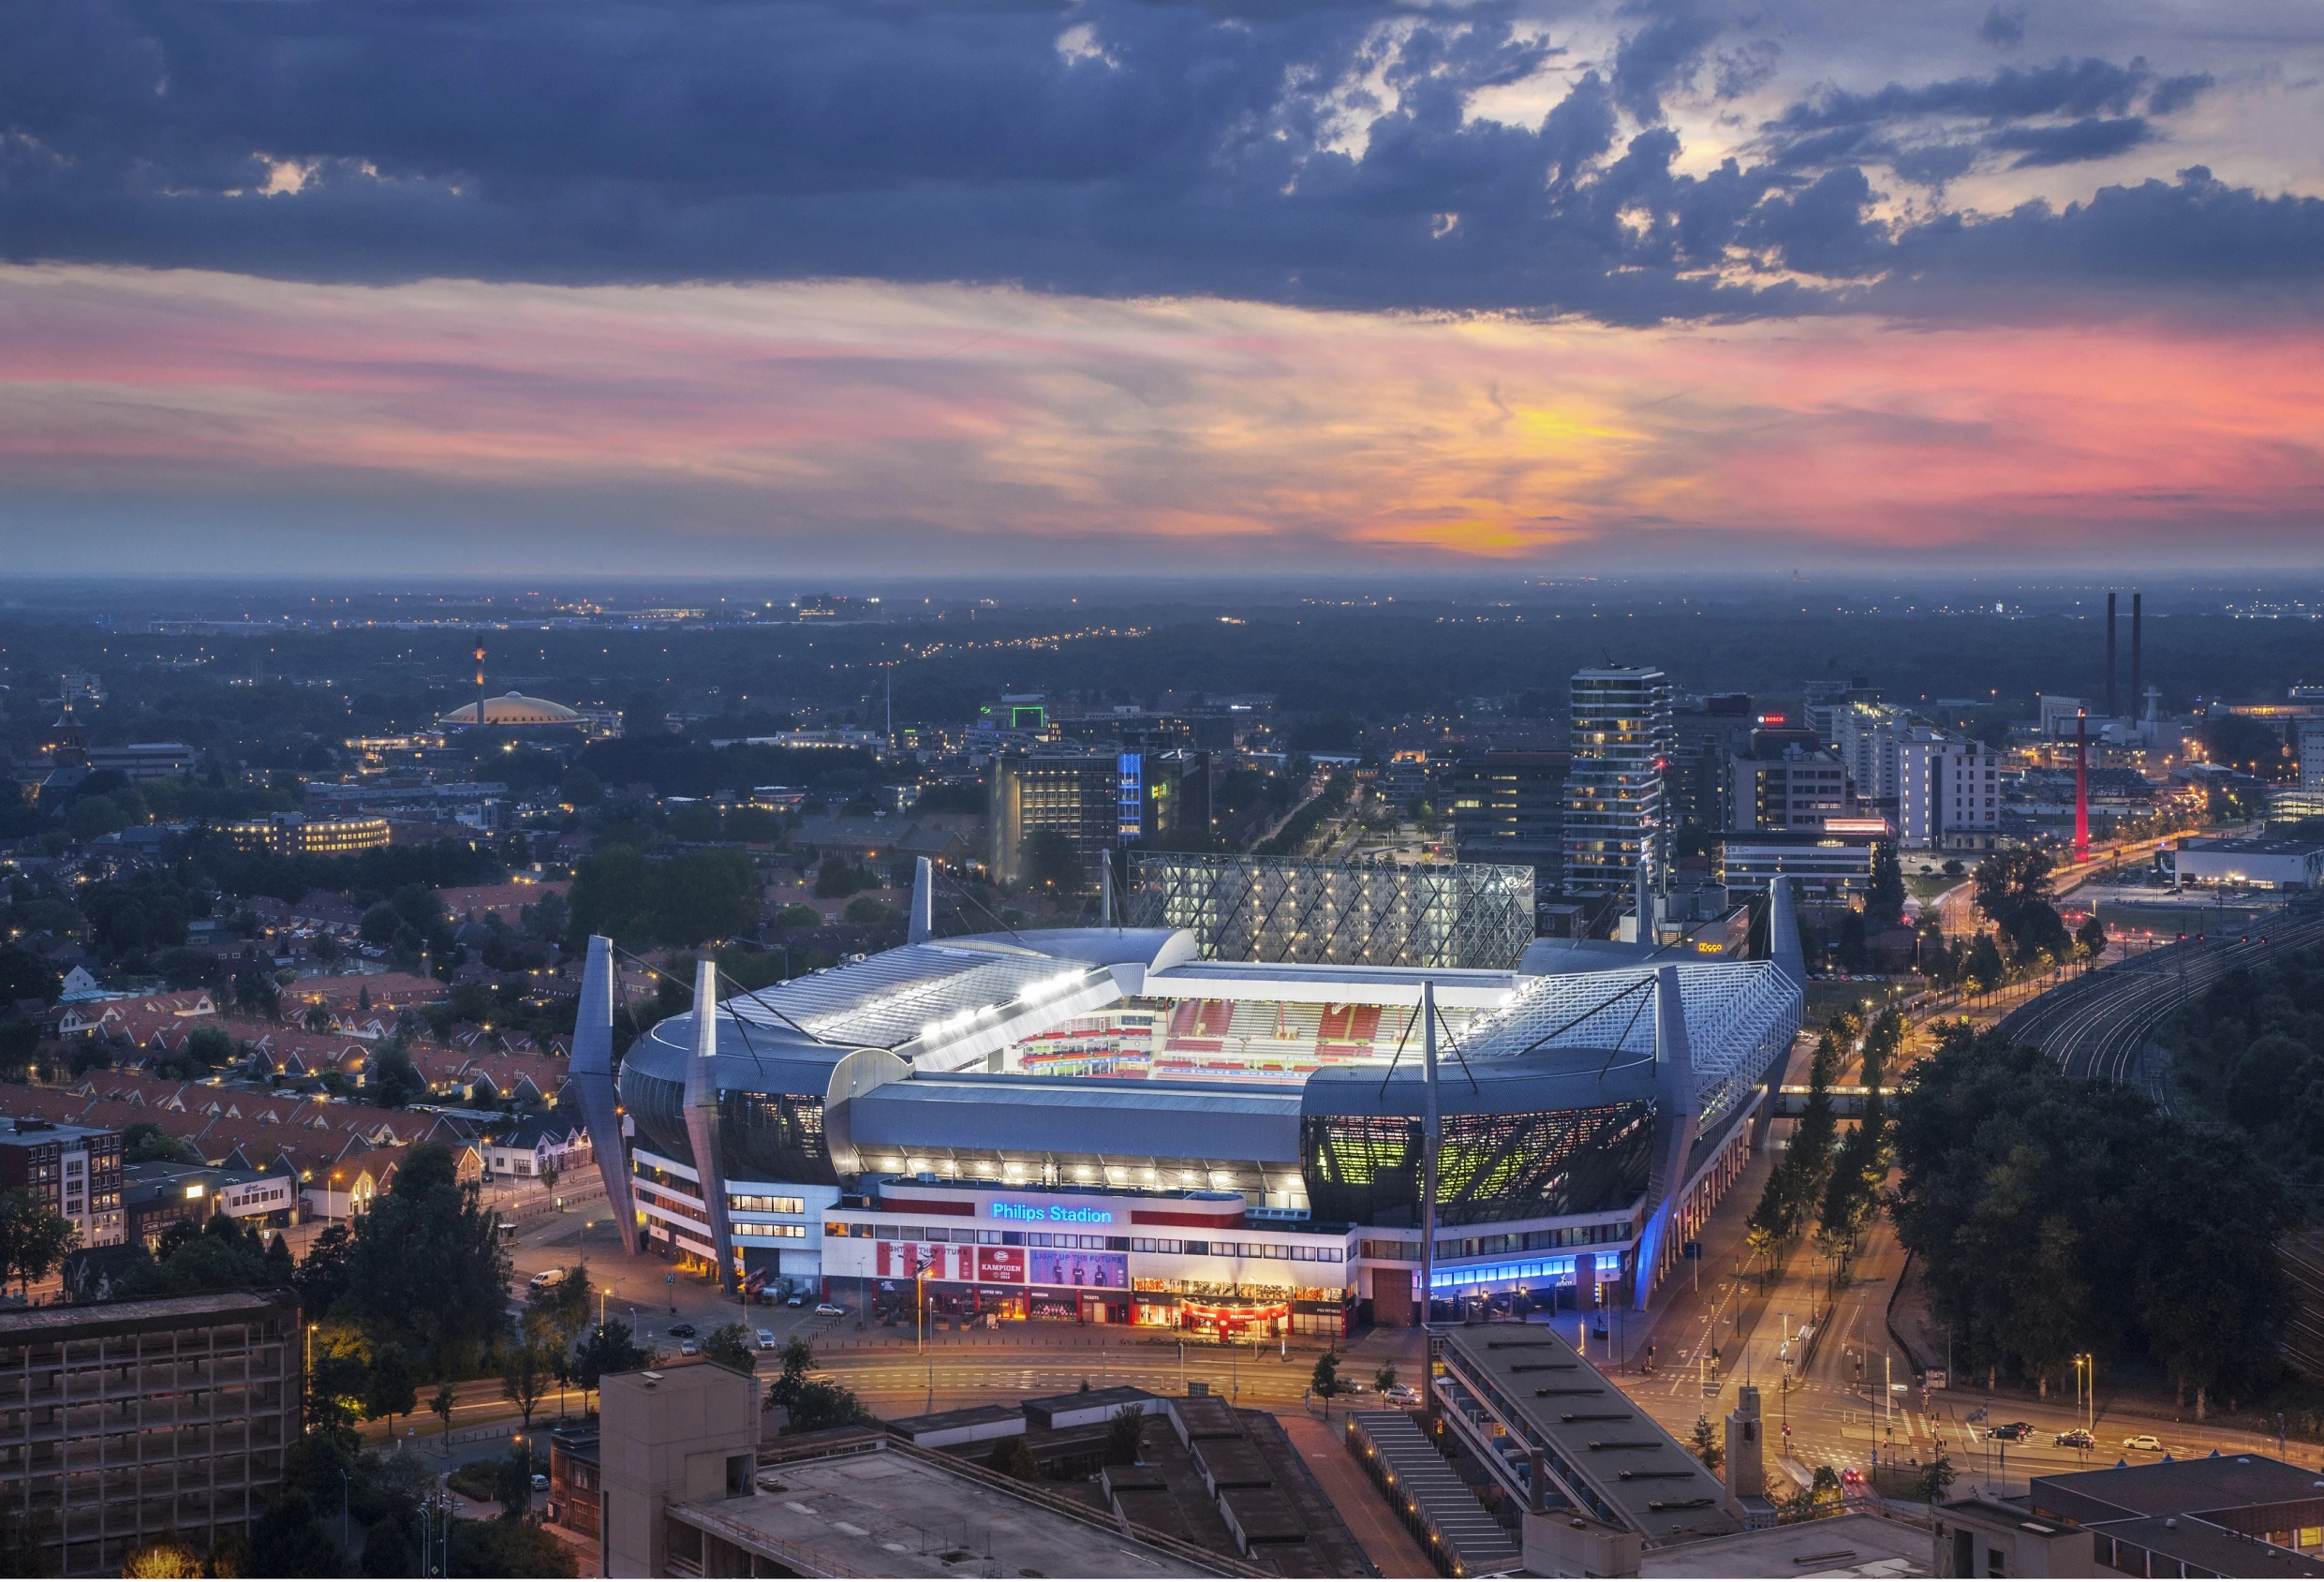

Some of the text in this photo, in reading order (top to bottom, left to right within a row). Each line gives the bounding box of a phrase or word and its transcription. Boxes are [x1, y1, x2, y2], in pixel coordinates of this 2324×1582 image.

[993, 1203, 1112, 1223] Philips Stadion
[1034, 1252, 1058, 1261] LIGHT
[1089, 1255, 1122, 1264] FUTURE
[667, 1275, 674, 1283] P2
[1136, 1279, 1164, 1291] BASIC
